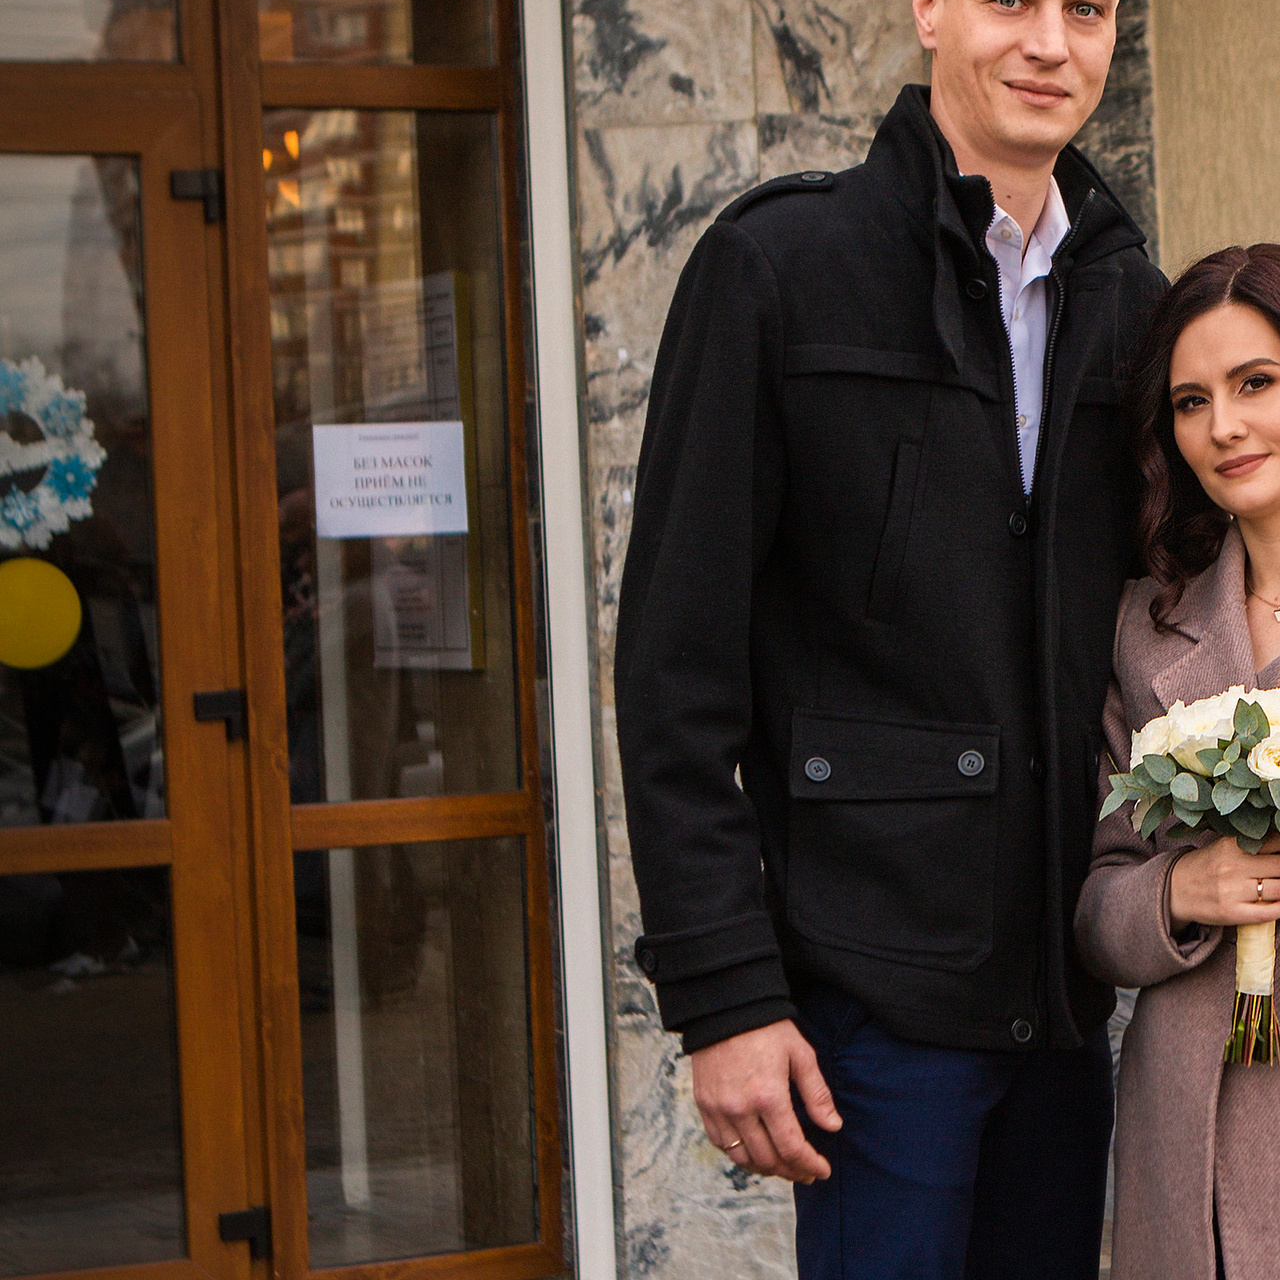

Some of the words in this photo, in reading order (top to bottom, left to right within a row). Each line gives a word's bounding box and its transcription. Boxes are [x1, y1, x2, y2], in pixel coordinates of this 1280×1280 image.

[353, 456, 377, 469] БЕЗ
[381, 455, 433, 468] МАСОК
[354, 475, 404, 489] ПРИЁМ
[408, 475, 426, 488] НЕ
[330, 493, 453, 509] ОСУЩЕСТВЛЯЕТСЯ
